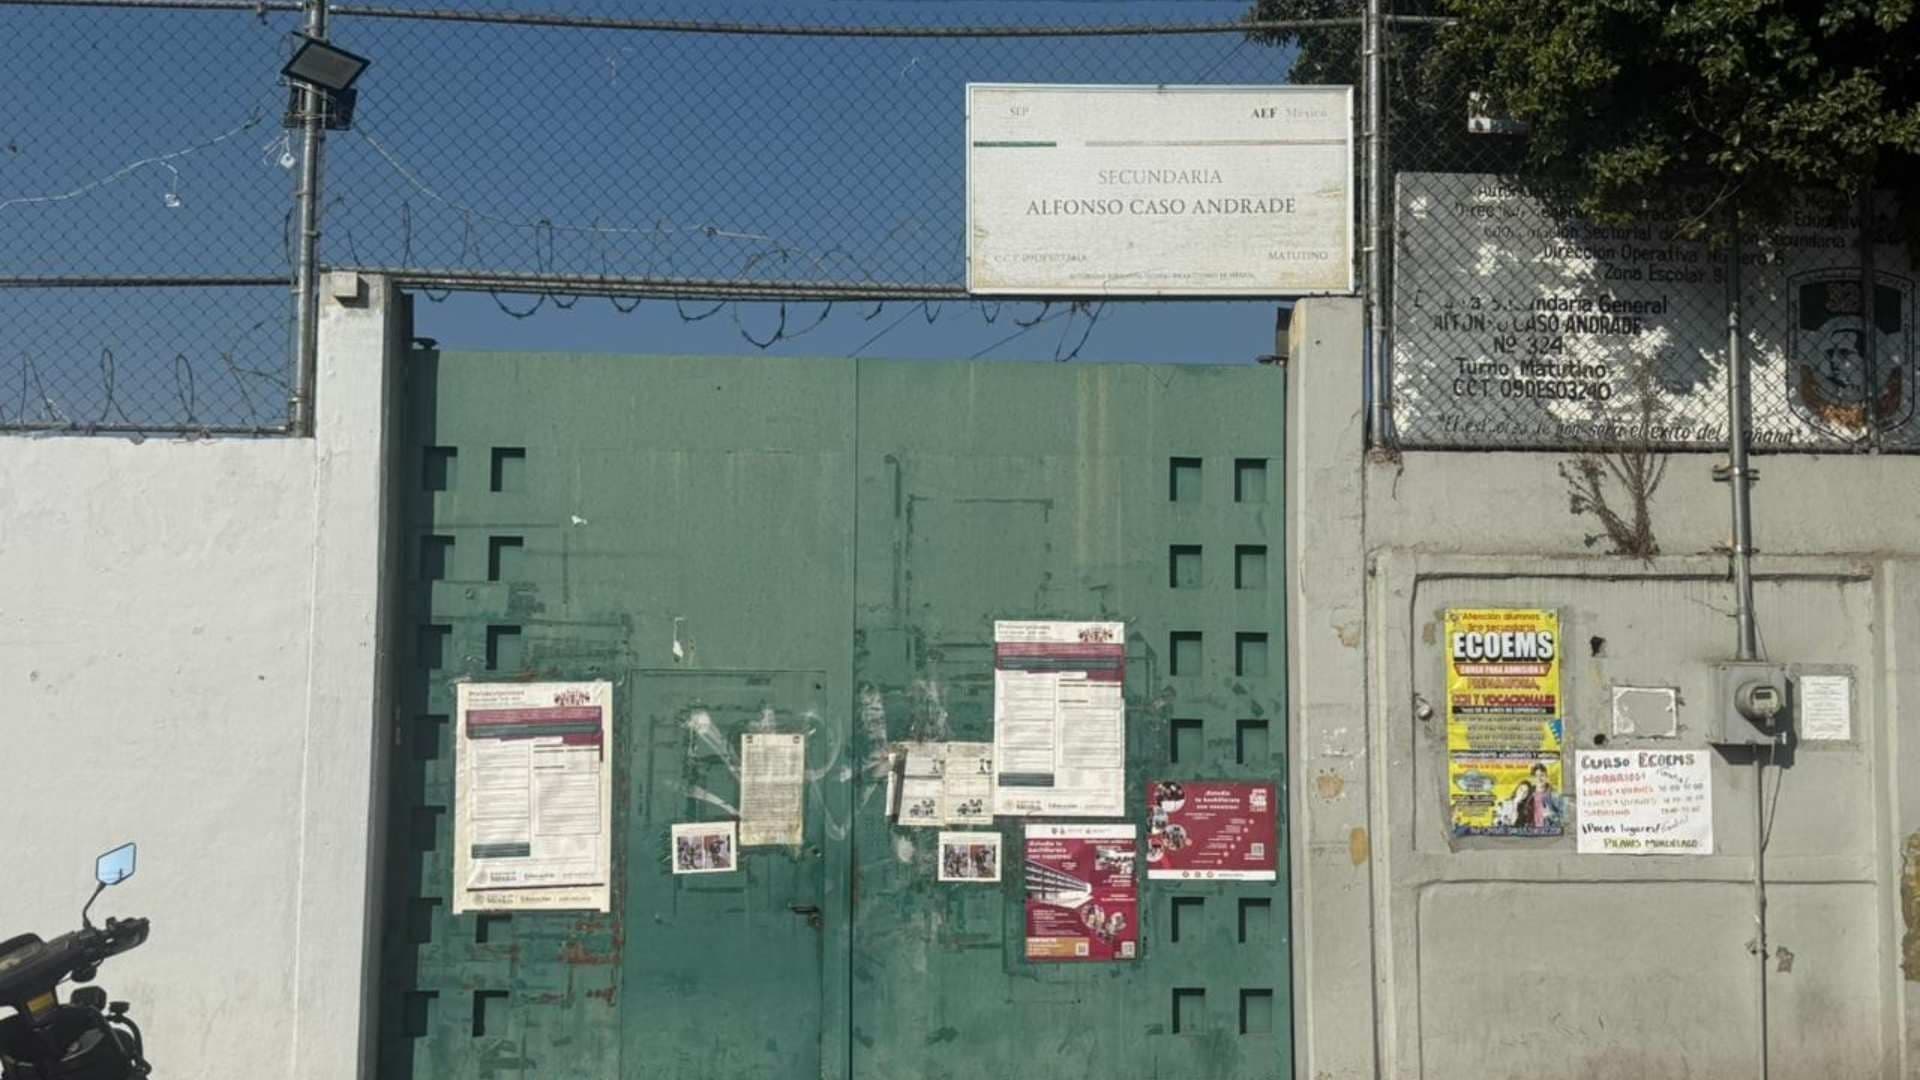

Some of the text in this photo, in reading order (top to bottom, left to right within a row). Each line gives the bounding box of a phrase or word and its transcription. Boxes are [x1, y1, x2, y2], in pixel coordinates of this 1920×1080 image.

[1098, 169, 1223, 184] SECUNDARIA
[1026, 197, 1296, 216] ALFONSO CASO ANDRADE
[1268, 251, 1328, 261] MATUTINO
[1620, 245, 1696, 263] Operativa
[1604, 265, 1642, 280] Zona
[1649, 265, 1704, 283] Escolar
[1600, 294, 1667, 314] General
[1527, 336, 1562, 353] 324
[1456, 357, 1606, 378] Turno Matutino
[1453, 631, 1554, 661] ECOEMS
